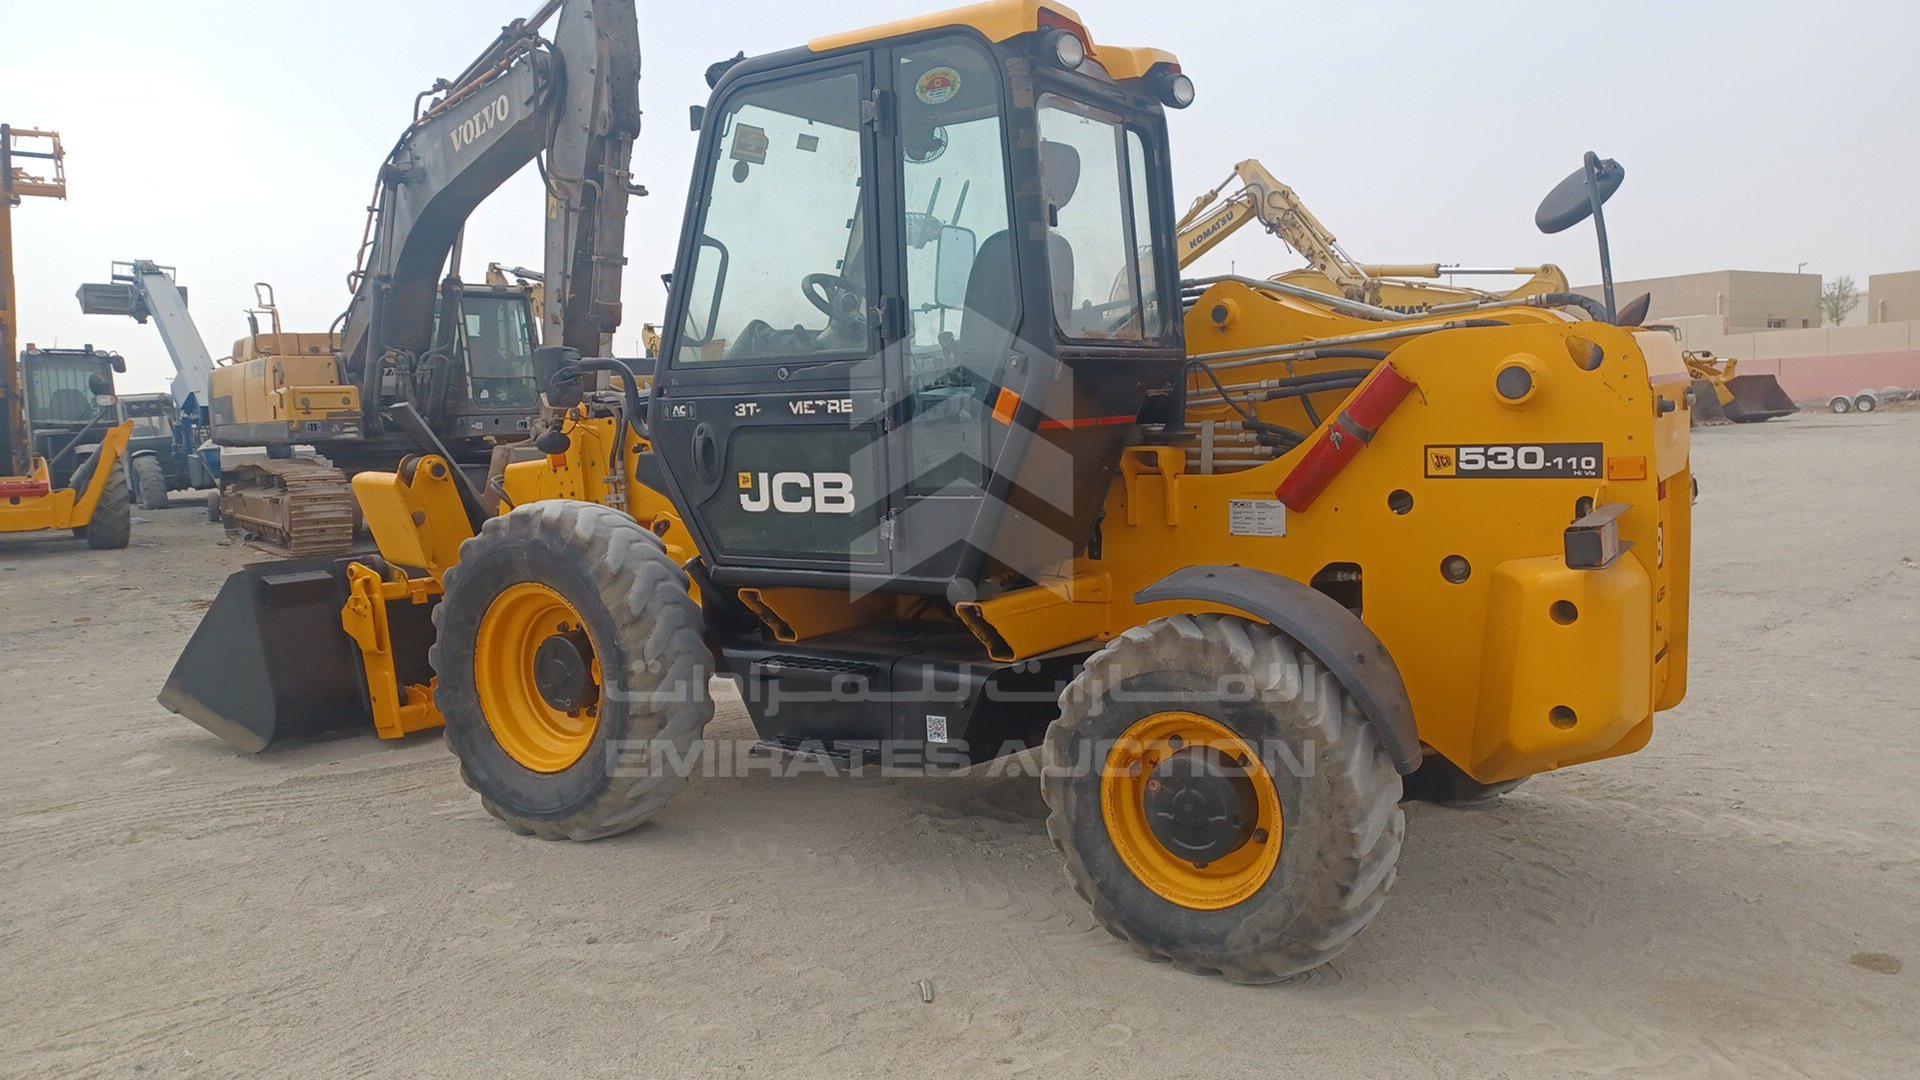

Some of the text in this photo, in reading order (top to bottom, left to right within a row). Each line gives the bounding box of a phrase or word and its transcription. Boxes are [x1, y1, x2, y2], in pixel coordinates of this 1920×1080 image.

[449, 94, 509, 152] VOLVO
[1189, 210, 1234, 249] KOMATSU
[672, 405, 687, 416] AC
[1458, 446, 1597, 470] 530-110
[739, 472, 856, 514] JCB
